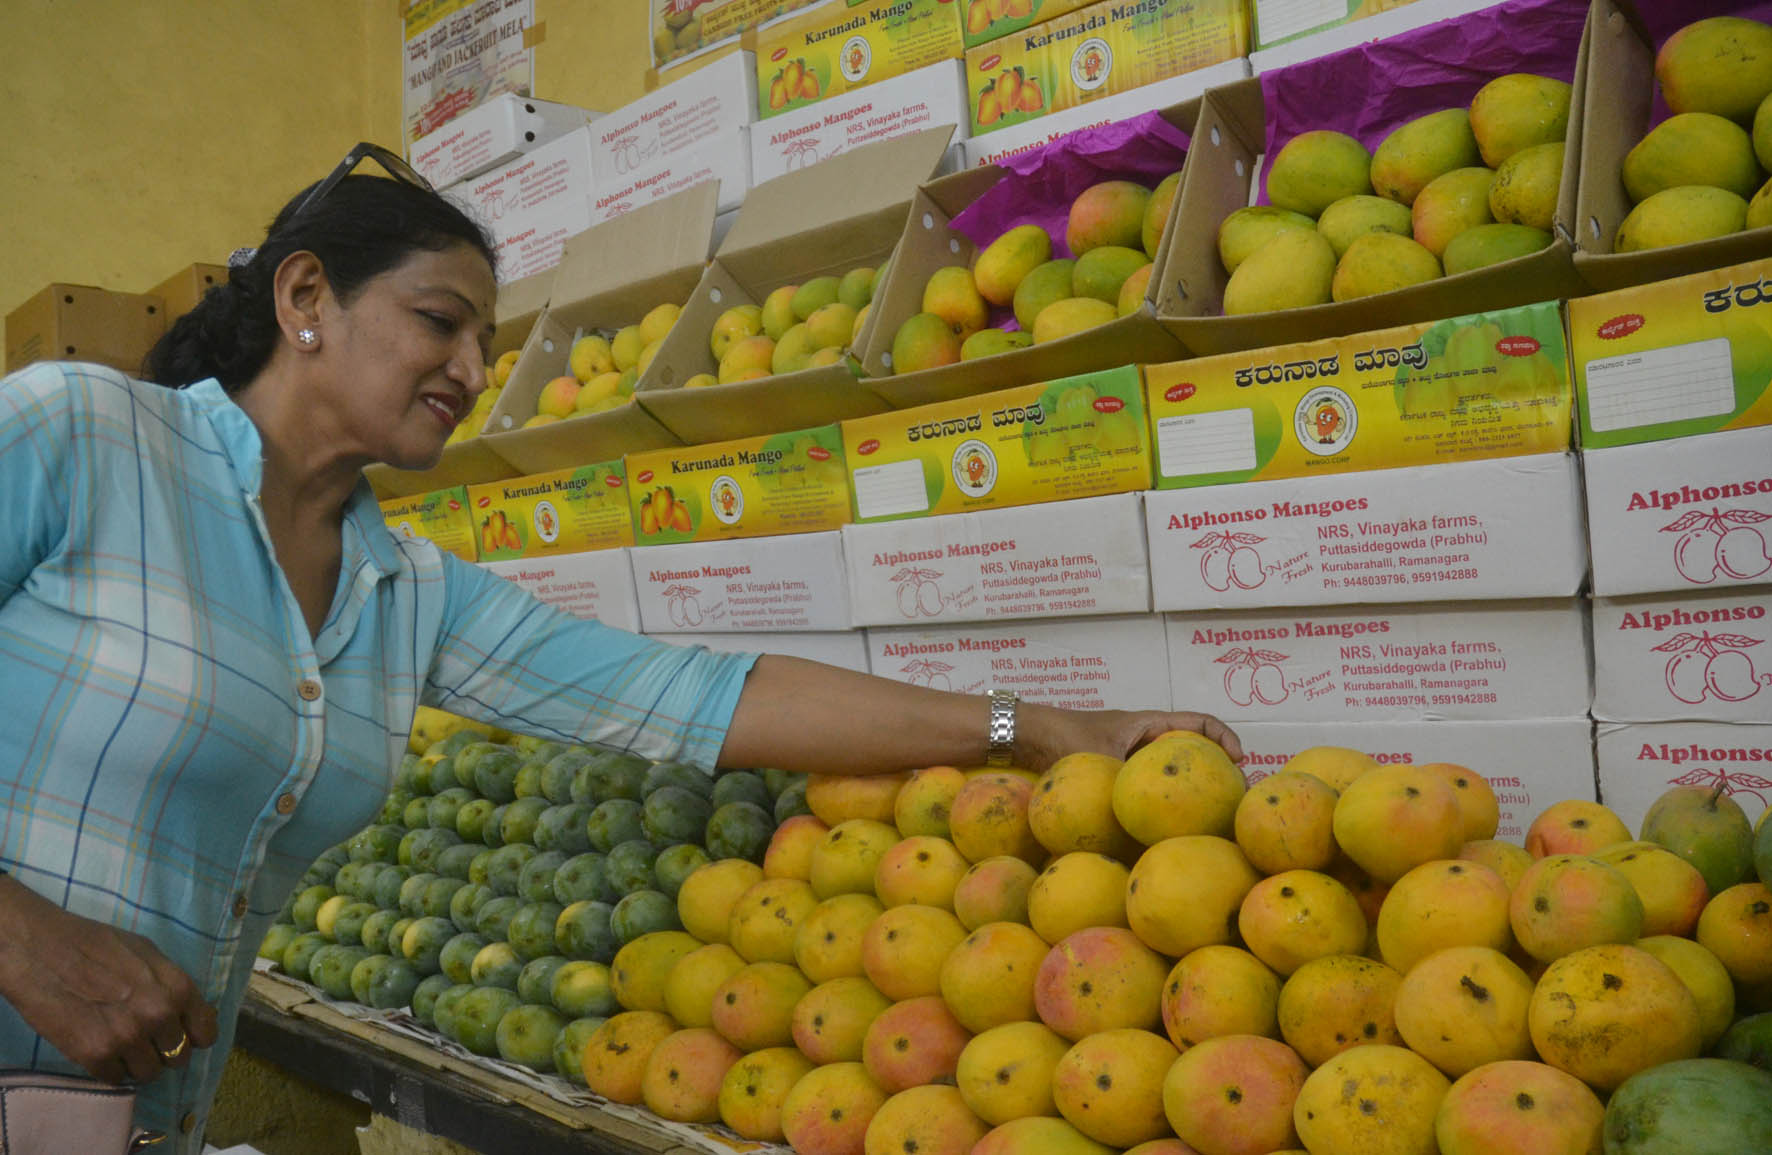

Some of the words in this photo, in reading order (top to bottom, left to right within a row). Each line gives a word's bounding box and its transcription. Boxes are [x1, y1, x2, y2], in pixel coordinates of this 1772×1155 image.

[804, 16, 866, 45] Karunada
[869, 1, 913, 24] Mango
[1025, 15, 1106, 51] Karunada
[1111, 0, 1167, 22] Mango
[770, 121, 822, 145] Alphonso
[824, 103, 872, 127] Mangoes
[596, 187, 634, 209] Alphonso
[635, 169, 671, 190] Mangoes
[1703, 272, 1772, 314] ಕರು
[1233, 348, 1340, 388] ಕರುನಾಡ
[1354, 337, 1430, 372] ಮಾವು
[907, 410, 983, 442] ಕರುನಾಡ
[991, 400, 1046, 427] ಮಾವು
[671, 456, 735, 474] Karunada
[737, 449, 783, 465] Mango
[503, 484, 551, 500] Karunada
[553, 477, 587, 494] Mango
[1626, 478, 1772, 512] Alphonso
[1167, 506, 1267, 531] Alphonso
[1272, 497, 1369, 519] Mangoes
[1317, 525, 1354, 541] NRS,
[1357, 517, 1428, 538] Vinayaka
[1431, 512, 1483, 529] farms,
[872, 547, 943, 567] Alphonso
[947, 538, 1017, 558] Mangoes
[1319, 536, 1427, 557] Puttasiddegowda
[1430, 530, 1488, 548] (Prabhu)
[648, 567, 701, 583] Alphonso
[702, 564, 752, 579] Mangoes
[980, 562, 1007, 576] NRS,
[1009, 556, 1059, 573] Vinayaka
[1060, 552, 1098, 567] farms,
[1265, 550, 1312, 576] Nature
[1281, 563, 1314, 585] Fresh
[1320, 557, 1397, 574] Kurubarahalli,
[1398, 552, 1471, 570] Ramanagara
[982, 573, 1059, 590] Puttasiddegowda
[1060, 567, 1102, 583] (Prabhu)
[1323, 578, 1341, 590] Ph:
[1343, 572, 1409, 588] 9448039796,
[1411, 568, 1479, 584] 9591942888
[1619, 606, 1766, 631] Alphonso
[1191, 626, 1290, 647] Alphonso
[1294, 620, 1391, 640] Mangoes
[883, 641, 955, 658] Alphonso
[958, 636, 1027, 652] Mangoes
[1339, 646, 1376, 660] NRS,
[1379, 642, 1448, 661] Vinayaka
[1450, 639, 1502, 655] farms,
[991, 658, 1017, 671] NRS,
[1019, 655, 1068, 671] Vinayaka
[1070, 654, 1107, 667] farms,
[1341, 659, 1447, 676] Puttasiddegowda
[1449, 657, 1507, 673] (Prabhu)
[992, 671, 1068, 686] Puttasiddegowda
[1070, 670, 1111, 683] (Prabhu)
[1287, 669, 1332, 693] Nature
[1420, 676, 1489, 690] Ramanagara
[1304, 681, 1337, 702] Fresh
[1345, 697, 1362, 708] Ph:
[1365, 694, 1430, 708] 9448039796,
[1432, 692, 1498, 706] 9591942888
[1489, 776, 1526, 789] rms,
